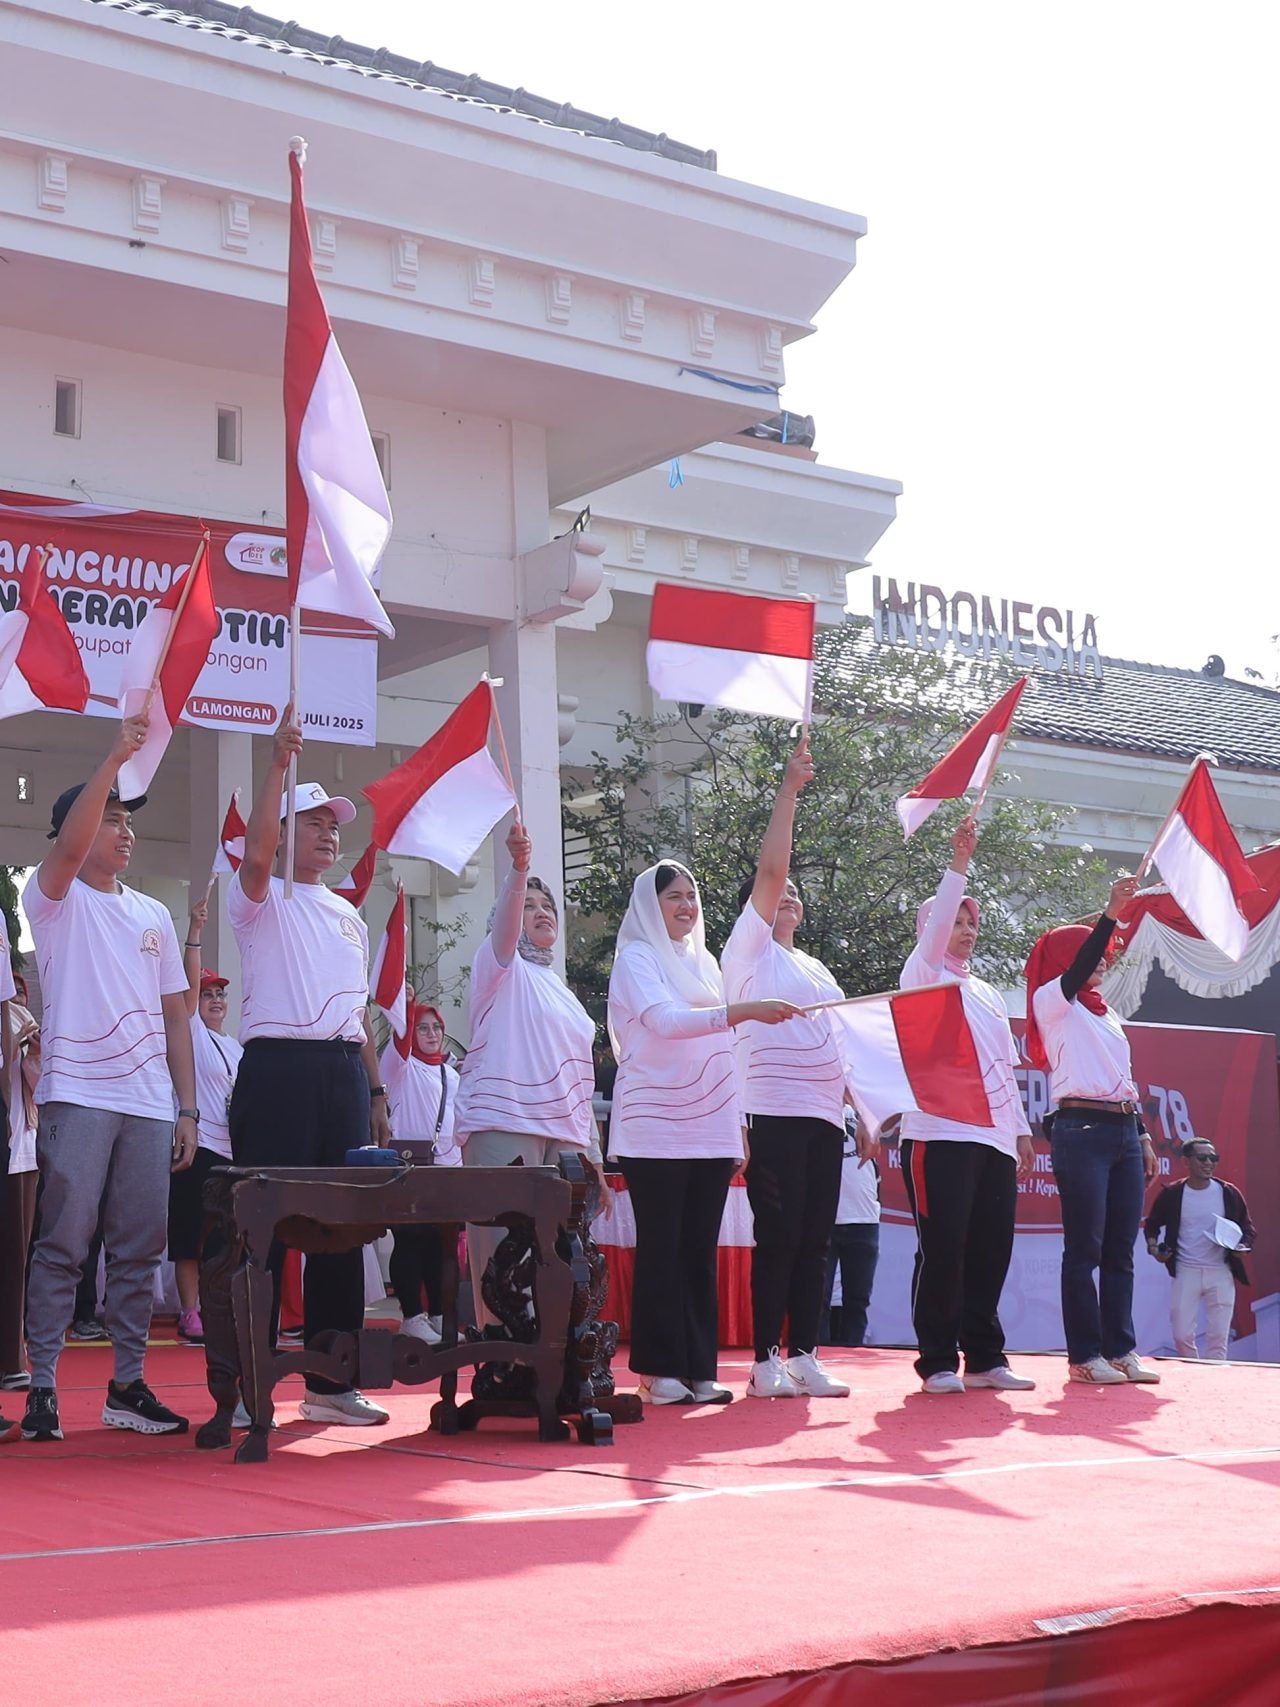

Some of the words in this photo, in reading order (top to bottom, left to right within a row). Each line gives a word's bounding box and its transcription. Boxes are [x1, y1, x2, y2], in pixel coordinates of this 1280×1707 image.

[52, 589, 148, 630] ERA
[872, 574, 1103, 679] INDONESIA
[192, 700, 272, 721] LAMONGAN
[303, 712, 330, 727] JULI
[333, 716, 364, 730] 2025
[1148, 1084, 1195, 1142] 78
